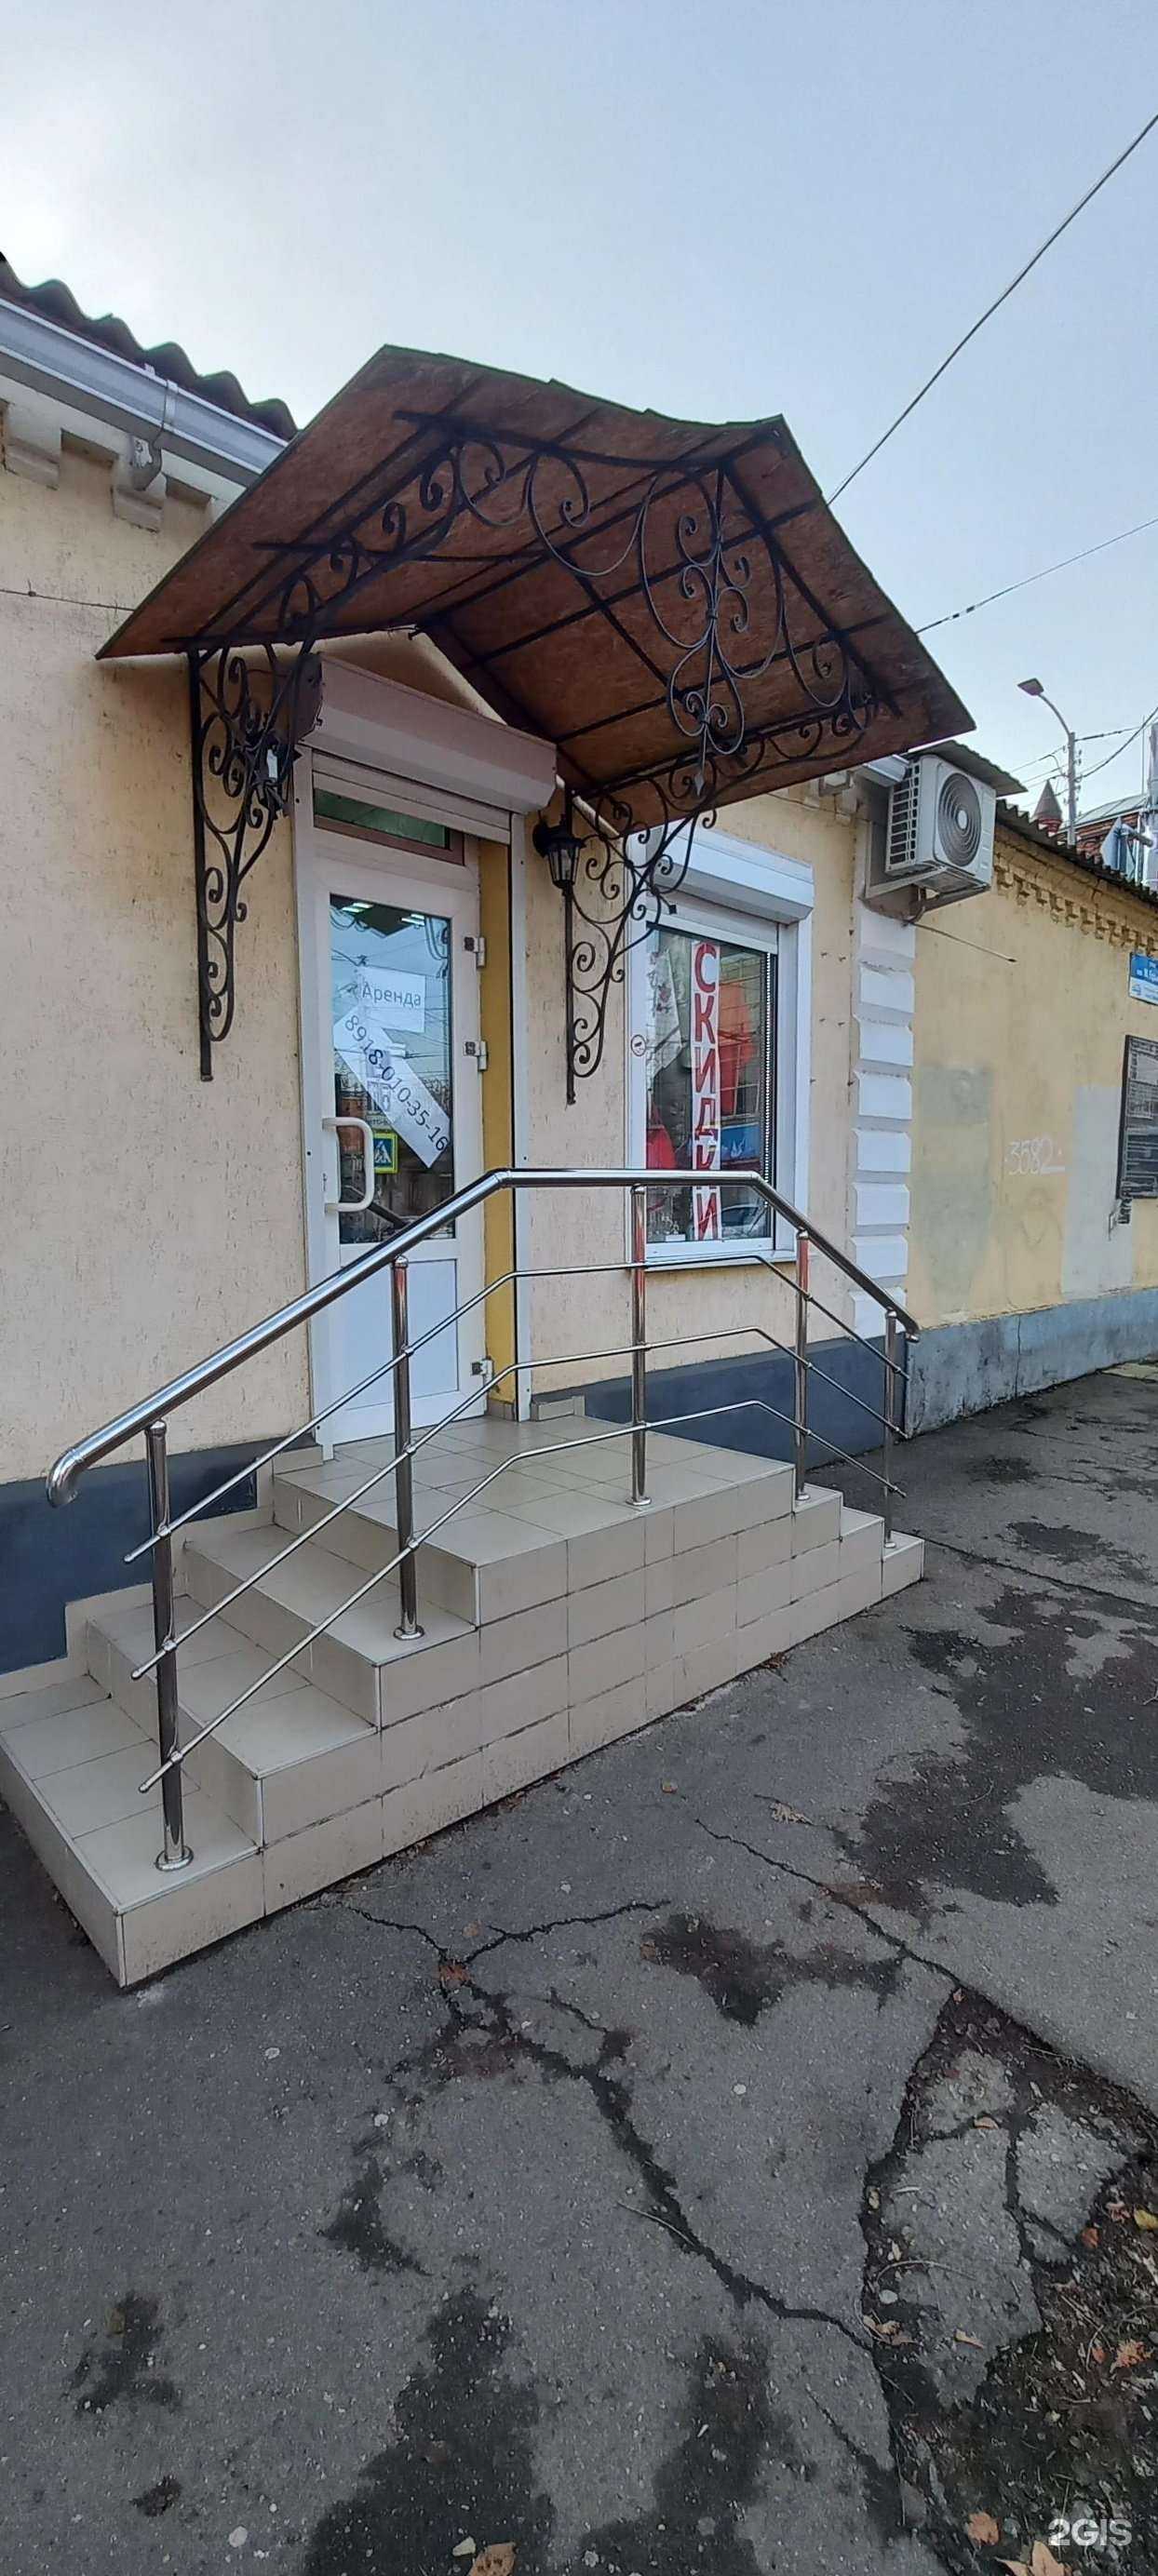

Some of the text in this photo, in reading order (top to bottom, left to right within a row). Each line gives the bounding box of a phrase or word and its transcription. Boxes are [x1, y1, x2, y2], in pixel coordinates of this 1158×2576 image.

[362, 981, 422, 1008] Аренда
[344, 1014, 449, 1151] 8918-010-35-16
[693, 942, 719, 1241] СКИДКИ
